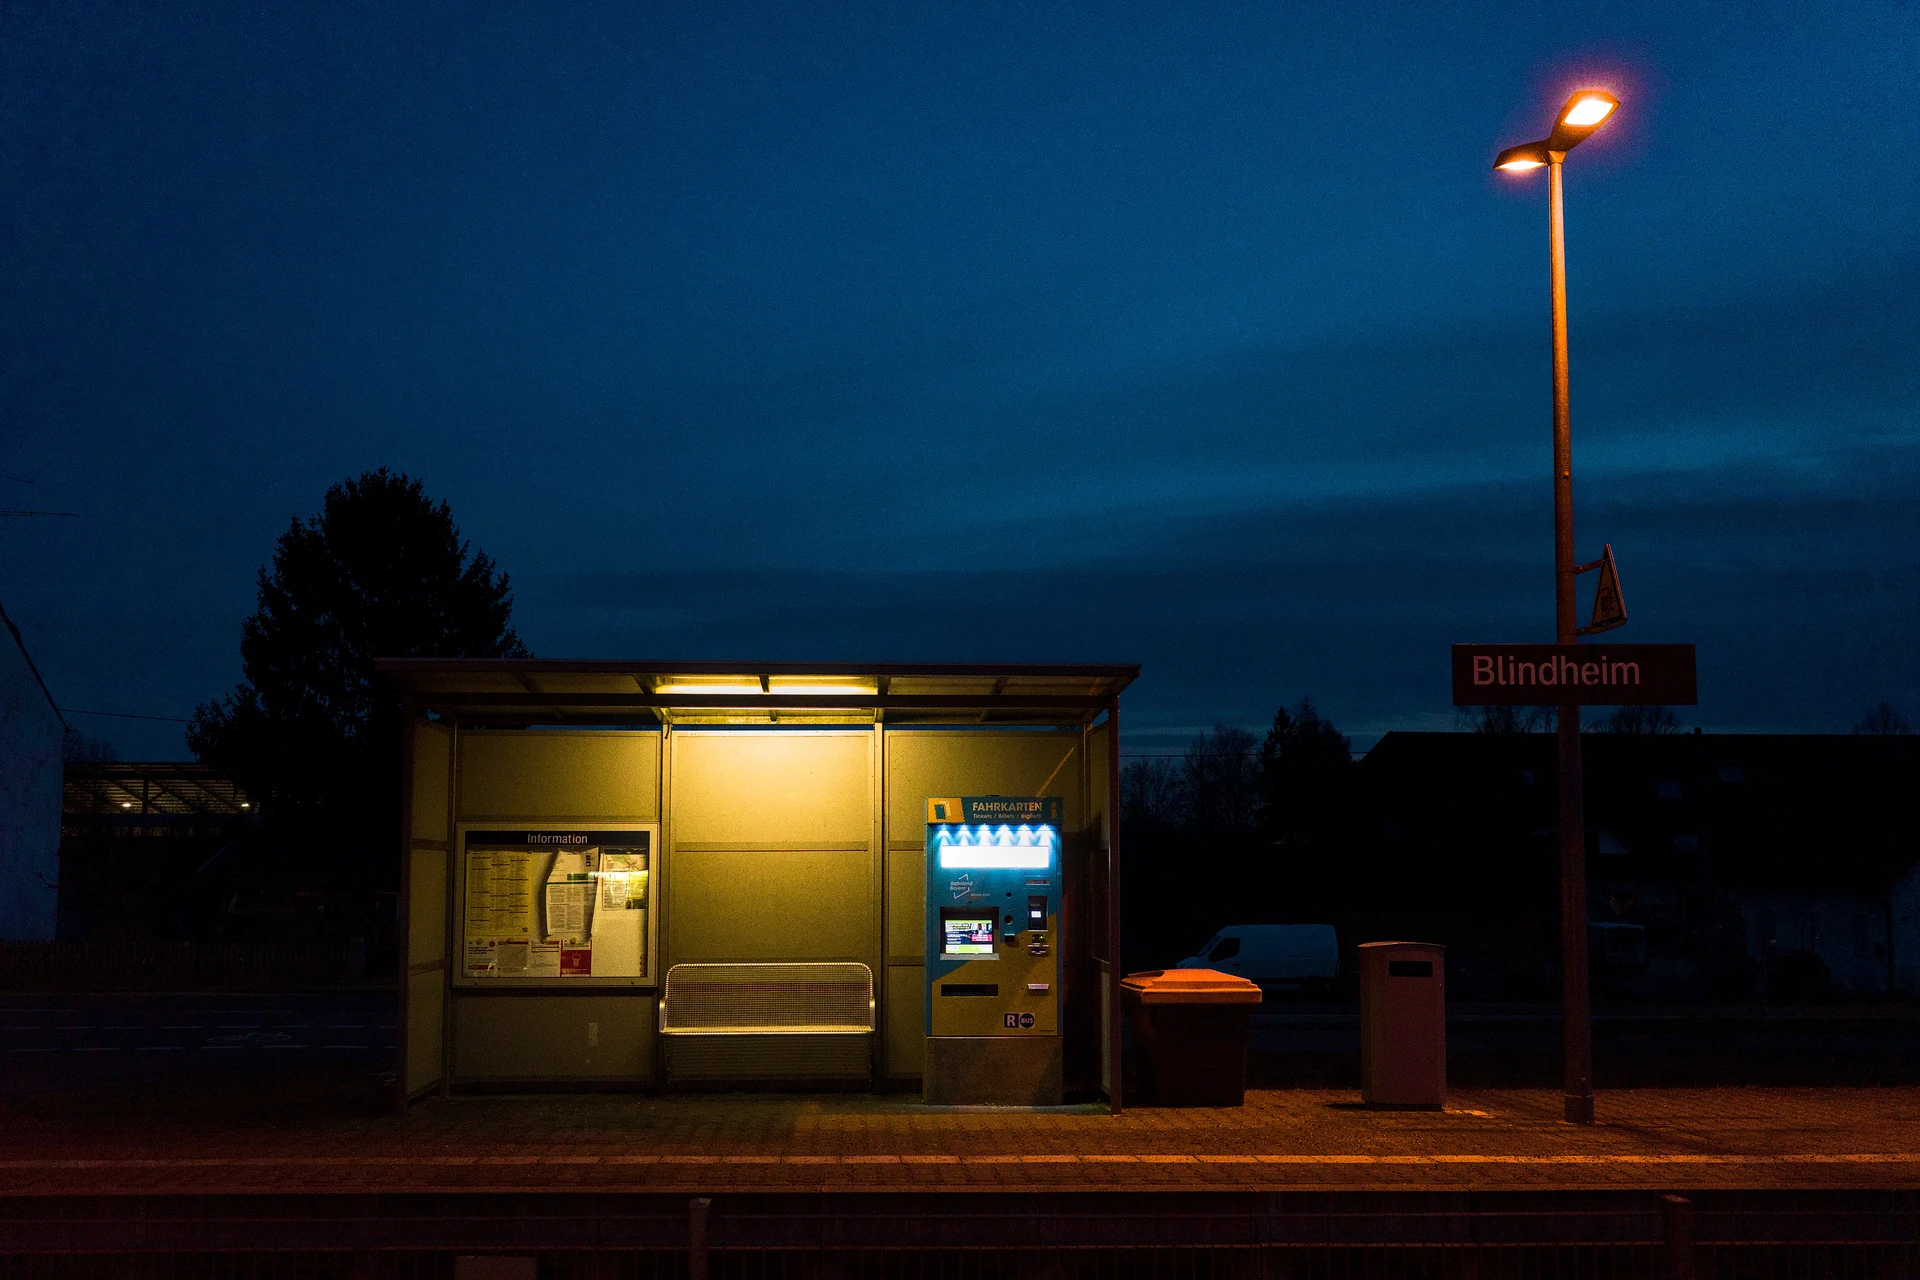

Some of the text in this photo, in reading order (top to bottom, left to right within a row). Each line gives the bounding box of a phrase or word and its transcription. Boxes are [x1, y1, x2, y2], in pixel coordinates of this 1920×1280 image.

[1472, 655, 1641, 686] Blindheim
[972, 802, 1043, 812] FAHRKARTEN
[527, 833, 588, 844] Information
[1006, 1014, 1016, 1027] R
